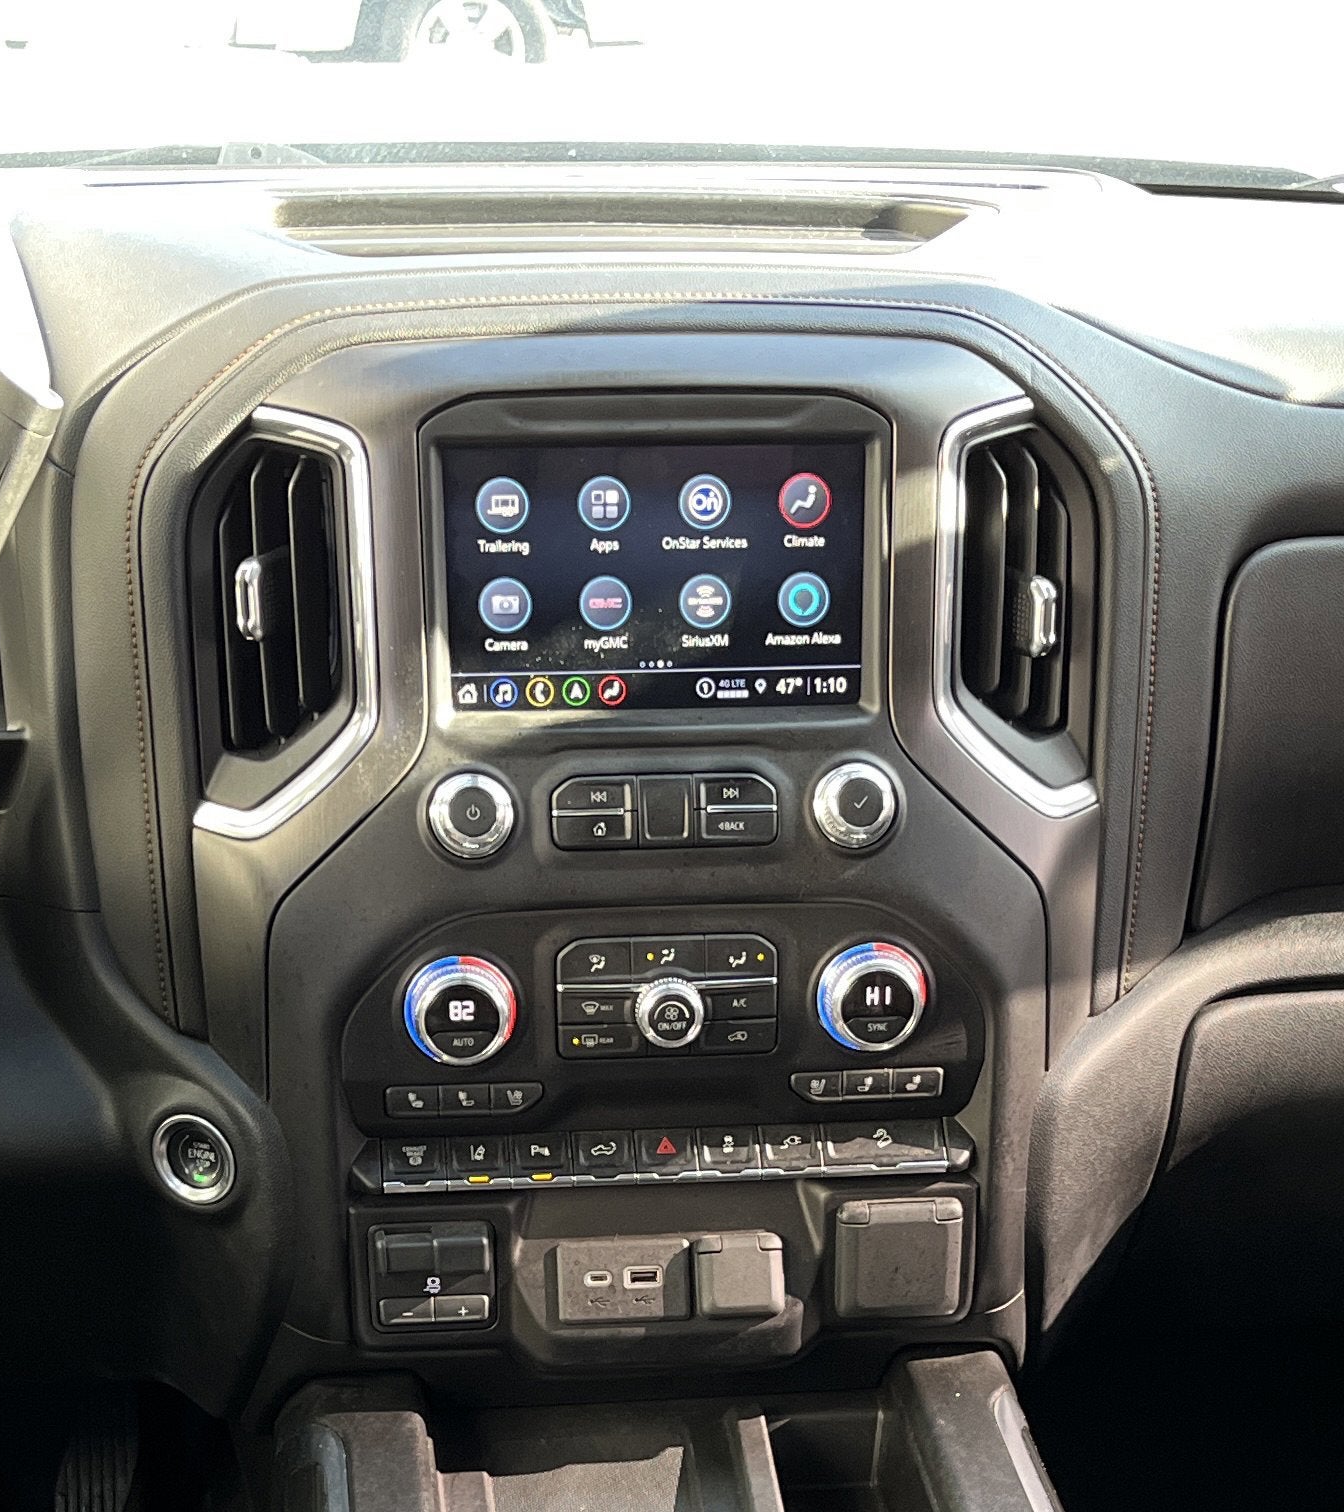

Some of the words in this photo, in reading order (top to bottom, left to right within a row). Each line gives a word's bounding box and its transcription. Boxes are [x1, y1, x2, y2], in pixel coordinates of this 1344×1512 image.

[477, 539, 530, 556] Trailering
[589, 538, 620, 553] Apps
[661, 536, 701, 550] OnStar
[702, 535, 748, 549] Services
[783, 534, 826, 548] Climate
[484, 637, 529, 651] Camera
[583, 636, 629, 652] myGMC
[681, 634, 729, 648] SiriusXM
[765, 632, 810, 646] Amazon
[811, 631, 842, 645] Alexa
[731, 678, 746, 688] LTE
[814, 676, 847, 693] 1:10
[724, 821, 745, 831] BACK
[732, 998, 748, 1008] A/C
[448, 1000, 475, 1021] 82
[657, 1021, 687, 1031] ON/OFF
[867, 1022, 889, 1032] SYNC
[452, 1037, 474, 1047] AUTO
